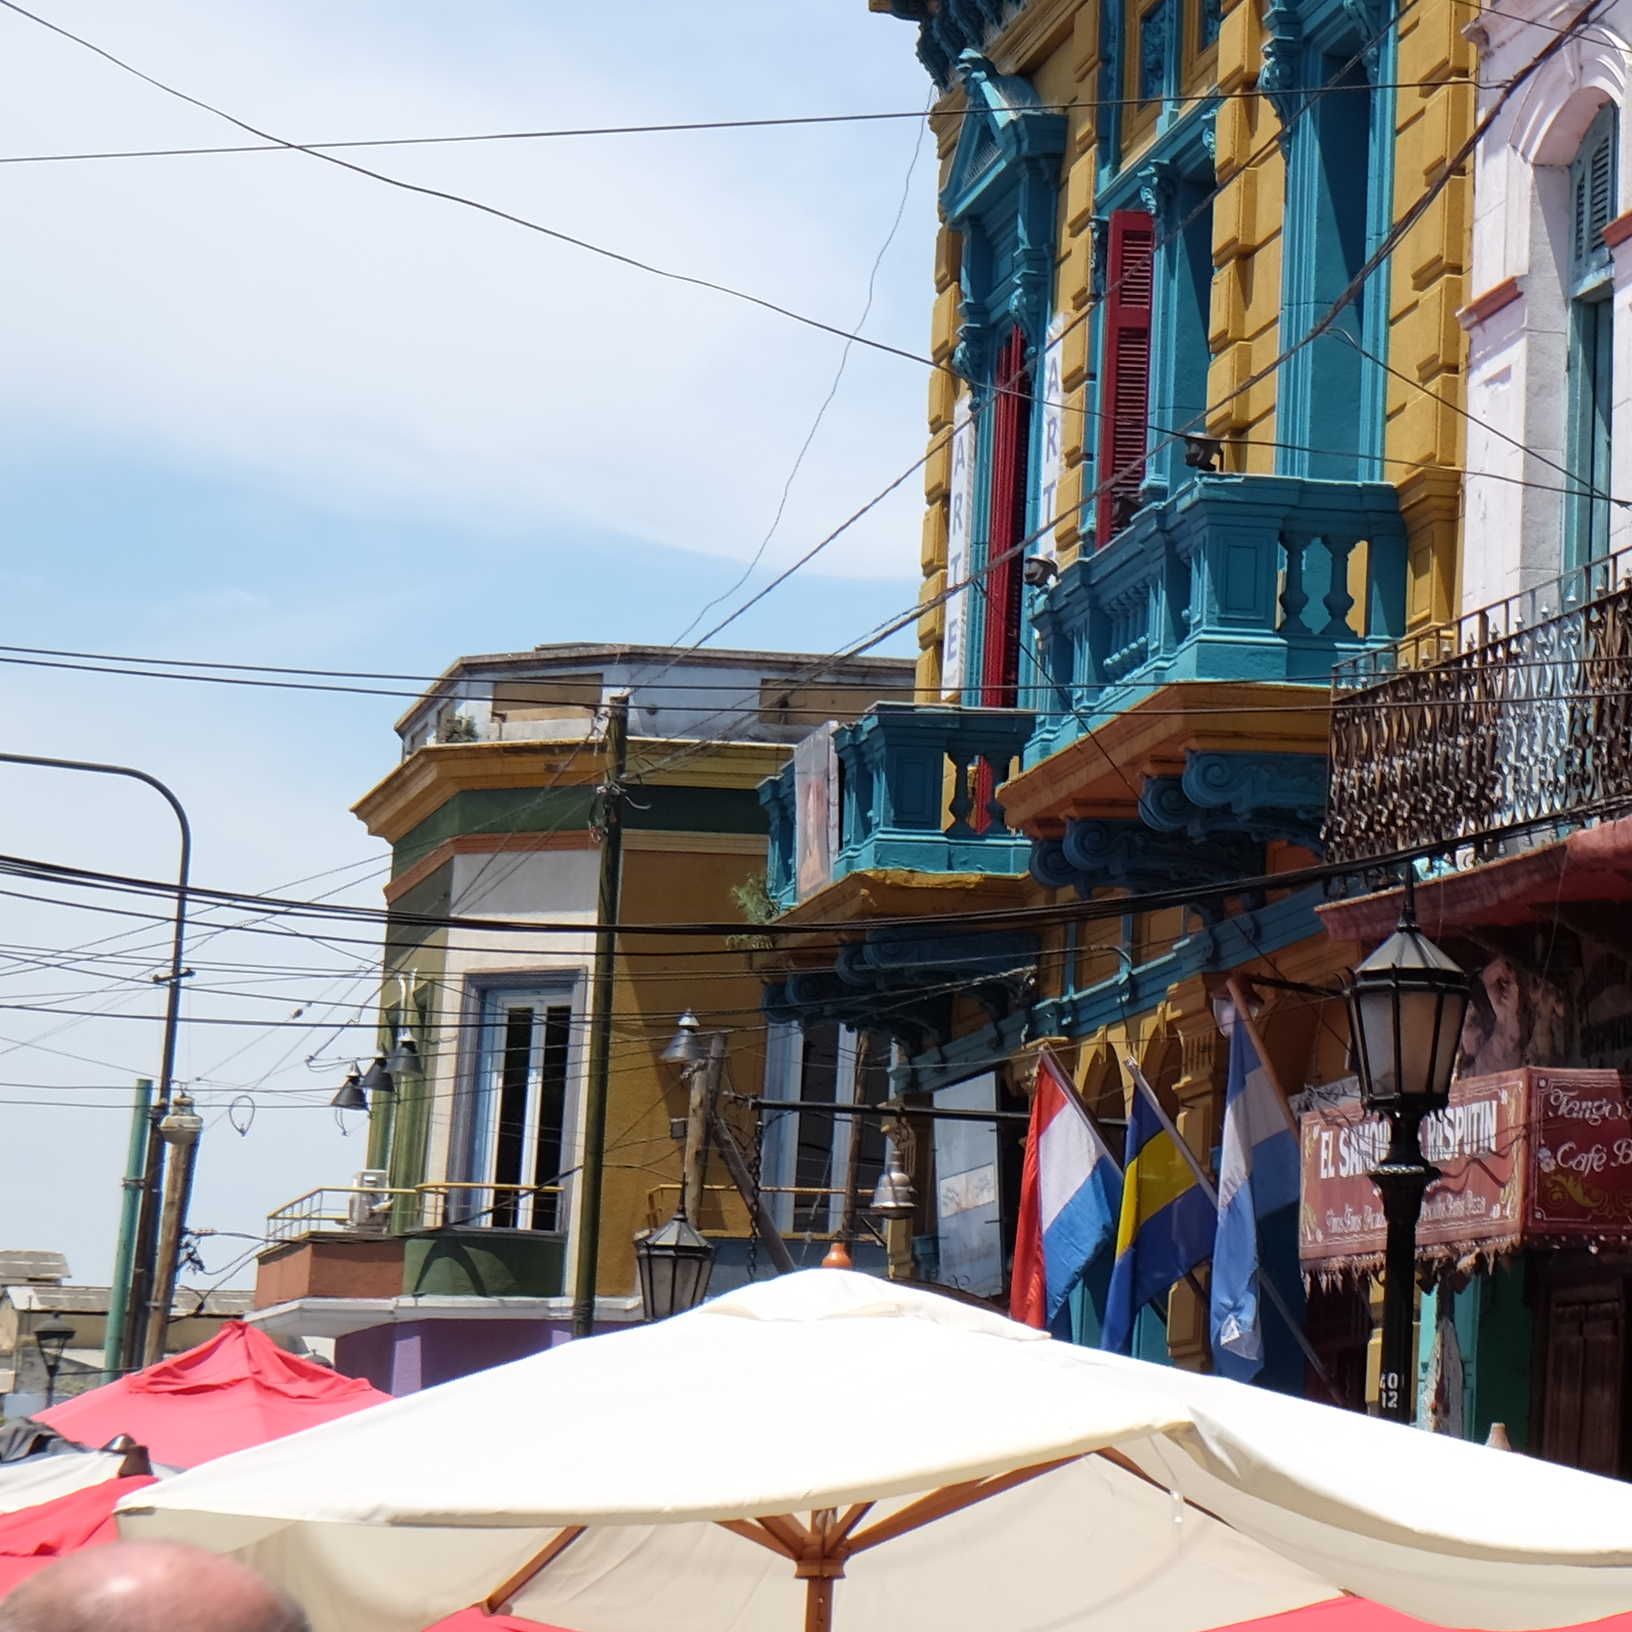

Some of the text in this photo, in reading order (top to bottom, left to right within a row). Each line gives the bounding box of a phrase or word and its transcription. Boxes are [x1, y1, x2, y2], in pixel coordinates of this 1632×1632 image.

[1043, 356, 1059, 558] ART
[947, 434, 966, 662] ARTE
[1320, 1130, 1336, 1179] EL
[1427, 1100, 1497, 1162] RASPUTIN
[1548, 1088, 1627, 1126] Tango
[1381, 1390, 1398, 1409] 12
